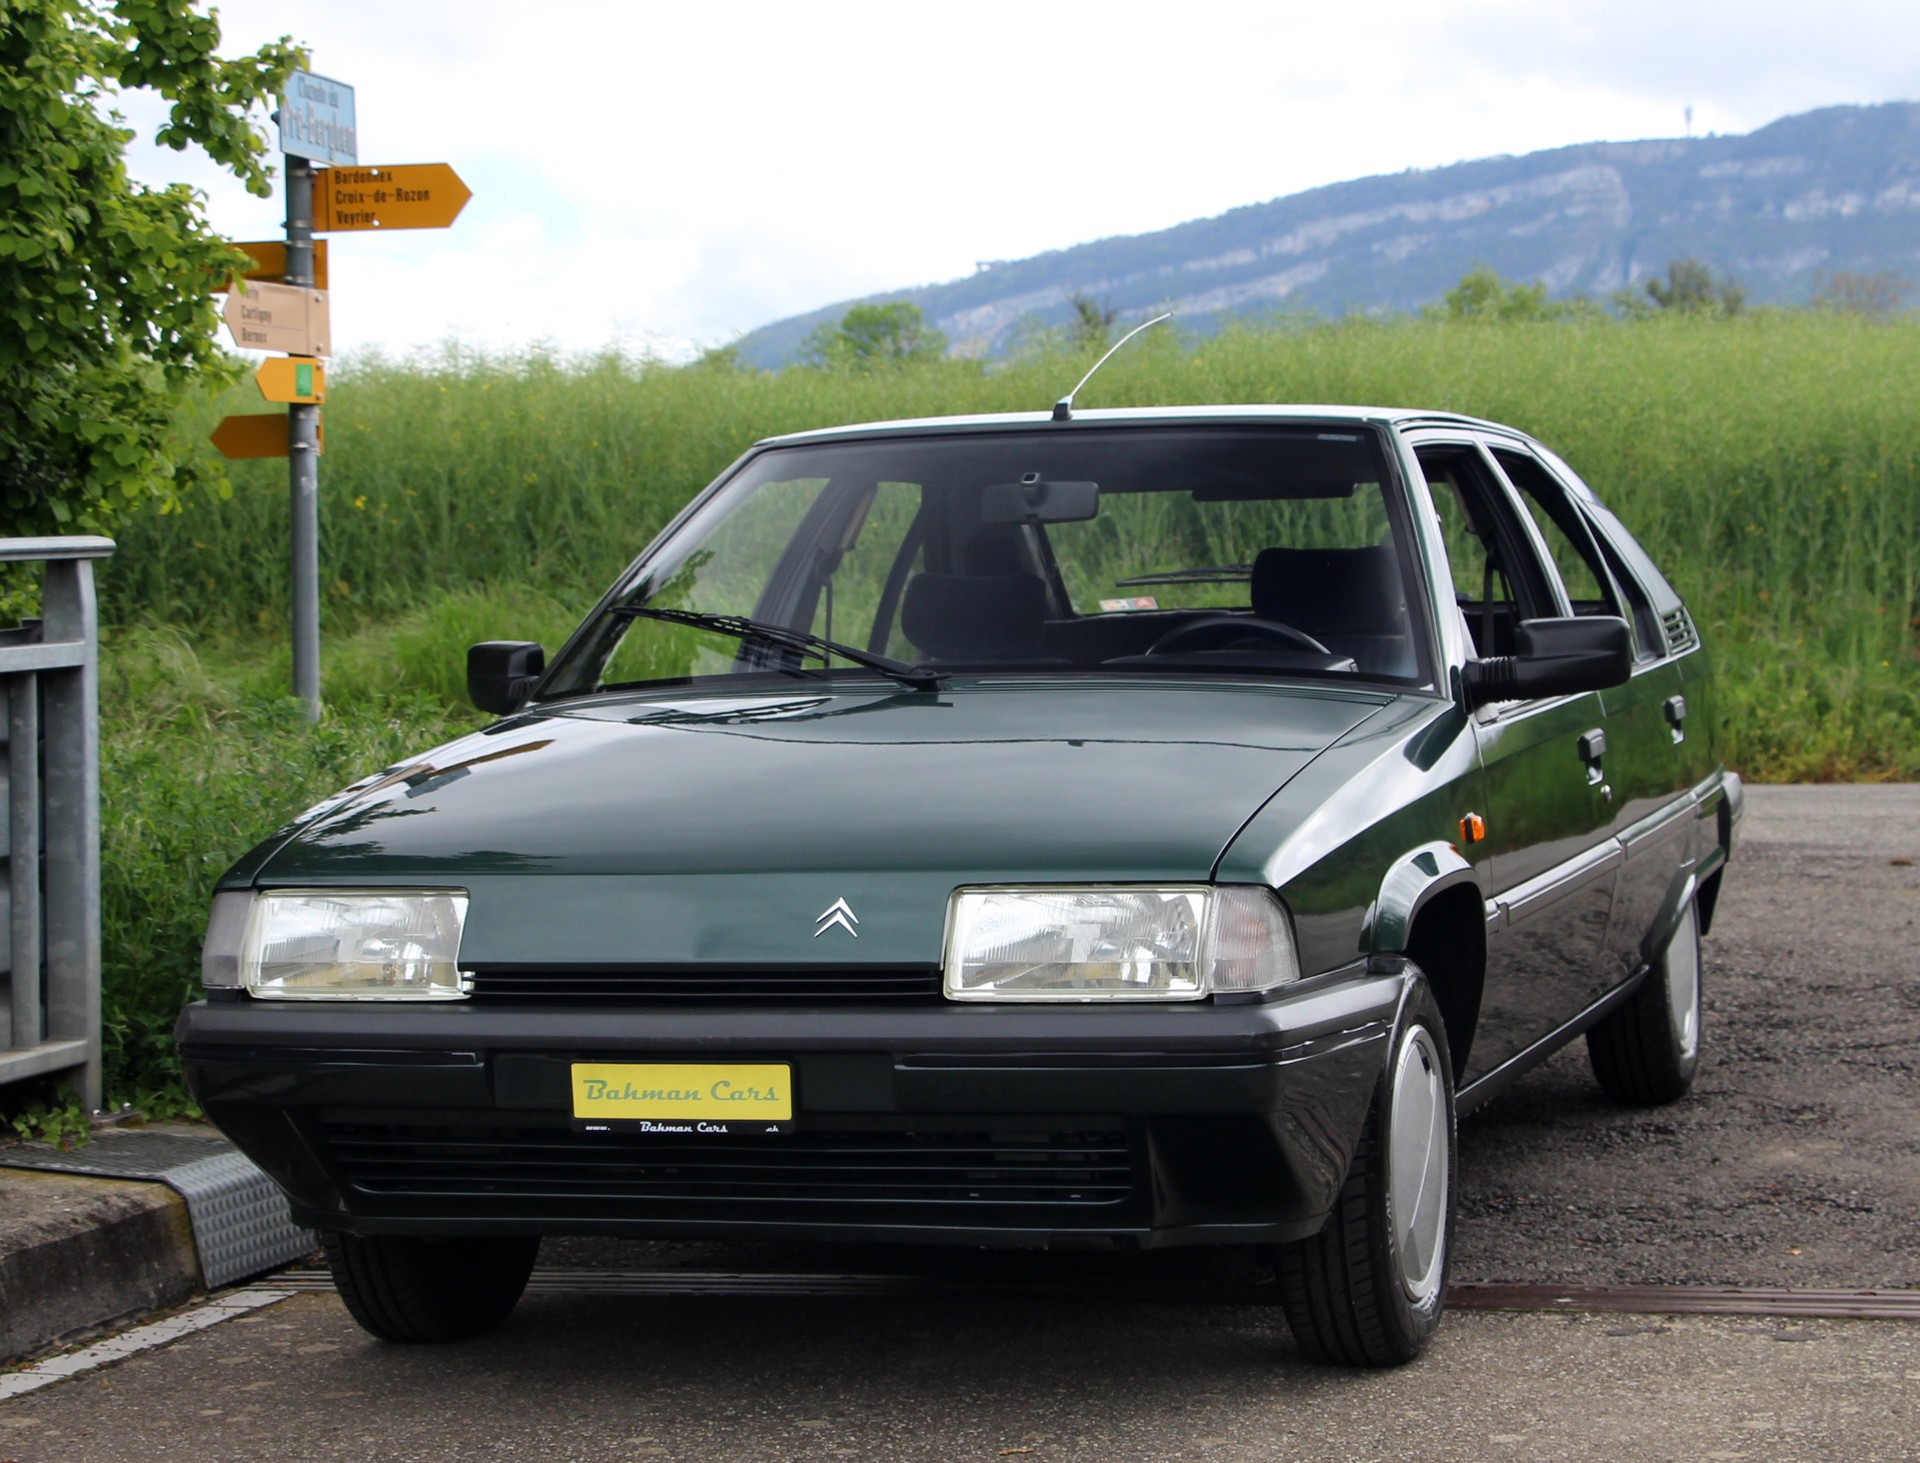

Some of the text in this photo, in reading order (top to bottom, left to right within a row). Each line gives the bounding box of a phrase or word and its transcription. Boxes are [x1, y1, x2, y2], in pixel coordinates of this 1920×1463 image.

[334, 170, 393, 185] Bardonnex
[335, 188, 430, 205] Croix-de-Rozon
[336, 210, 375, 226] Veyrier
[583, 1079, 780, 1102] Bahman Cars
[639, 1121, 693, 1132] Bahman
[697, 1122, 728, 1133] Cars
